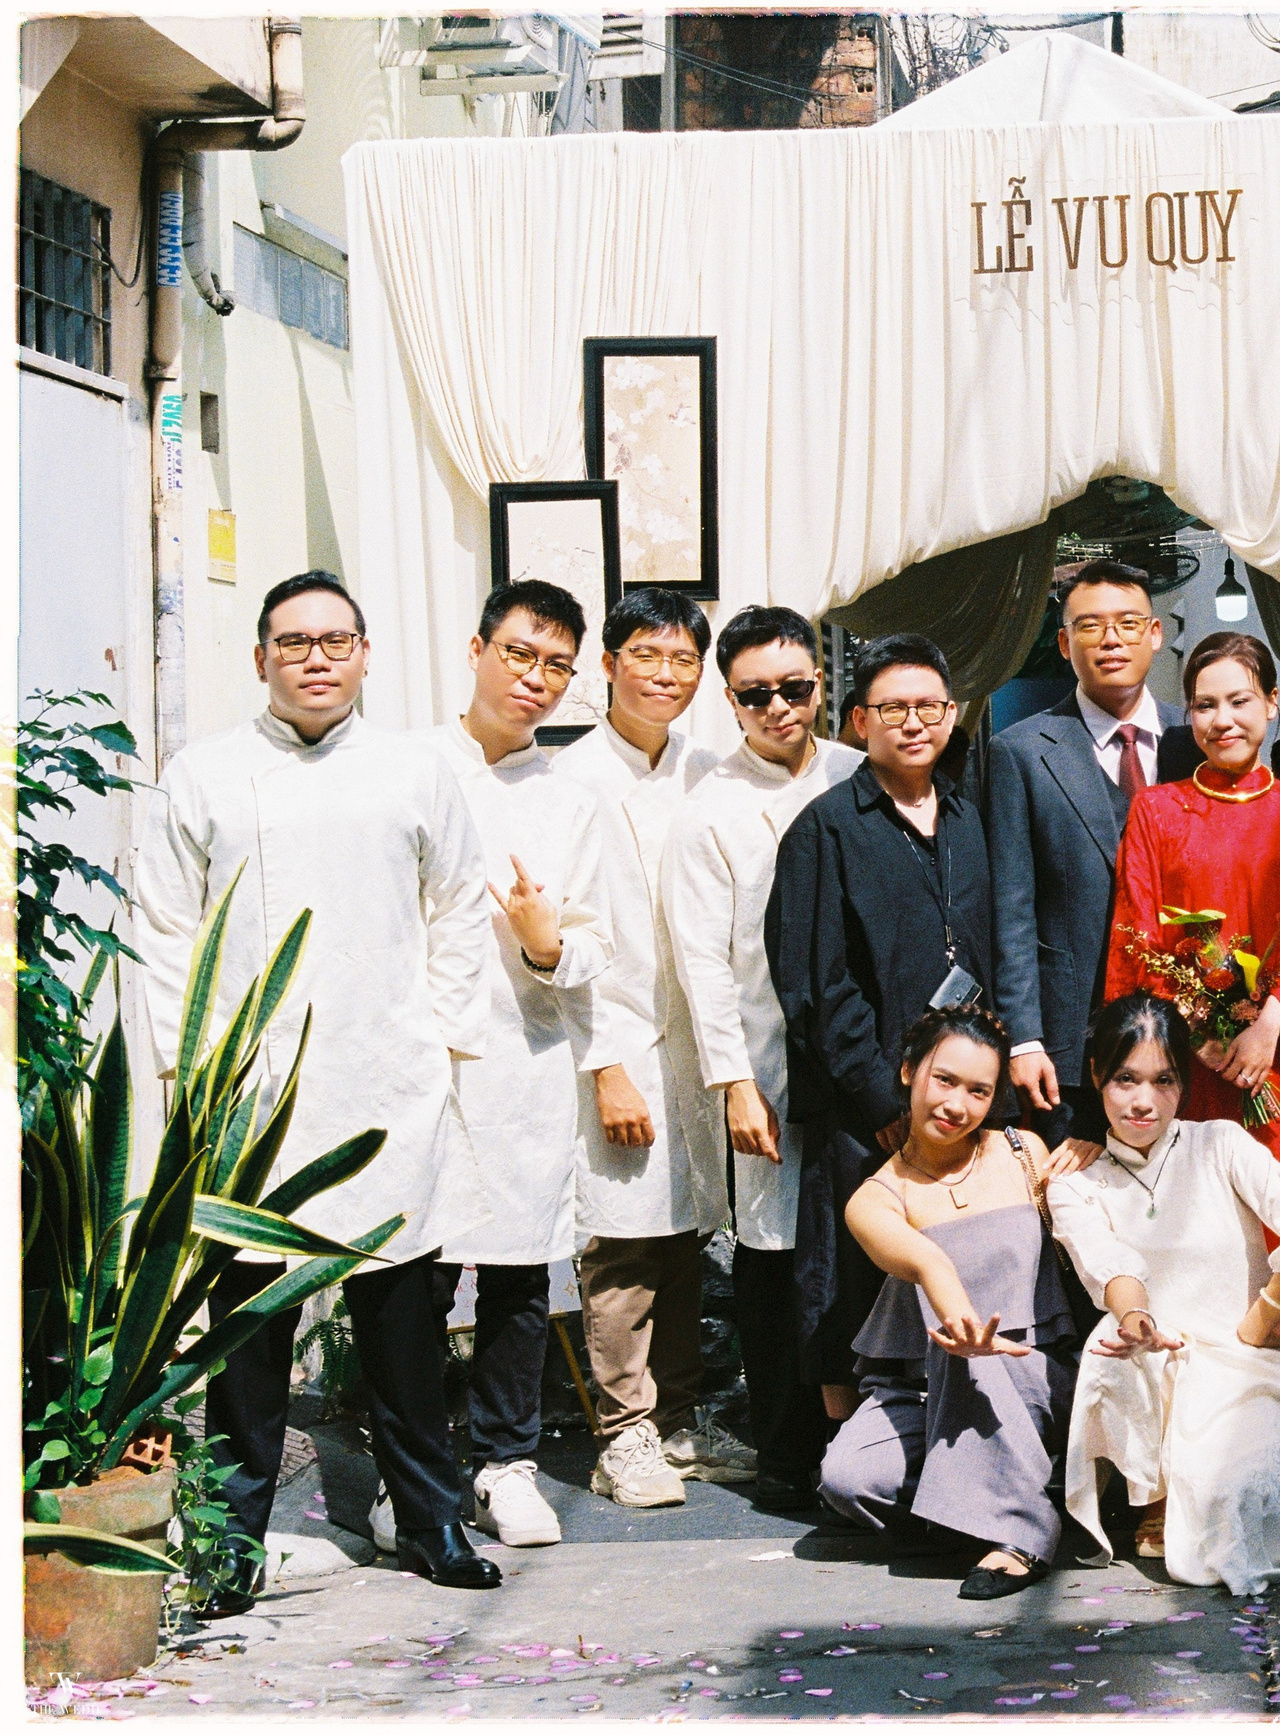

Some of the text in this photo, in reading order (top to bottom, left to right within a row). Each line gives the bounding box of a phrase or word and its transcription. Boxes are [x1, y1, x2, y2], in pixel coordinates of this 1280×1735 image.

[971, 176, 1244, 274] LỄ VU QUY
